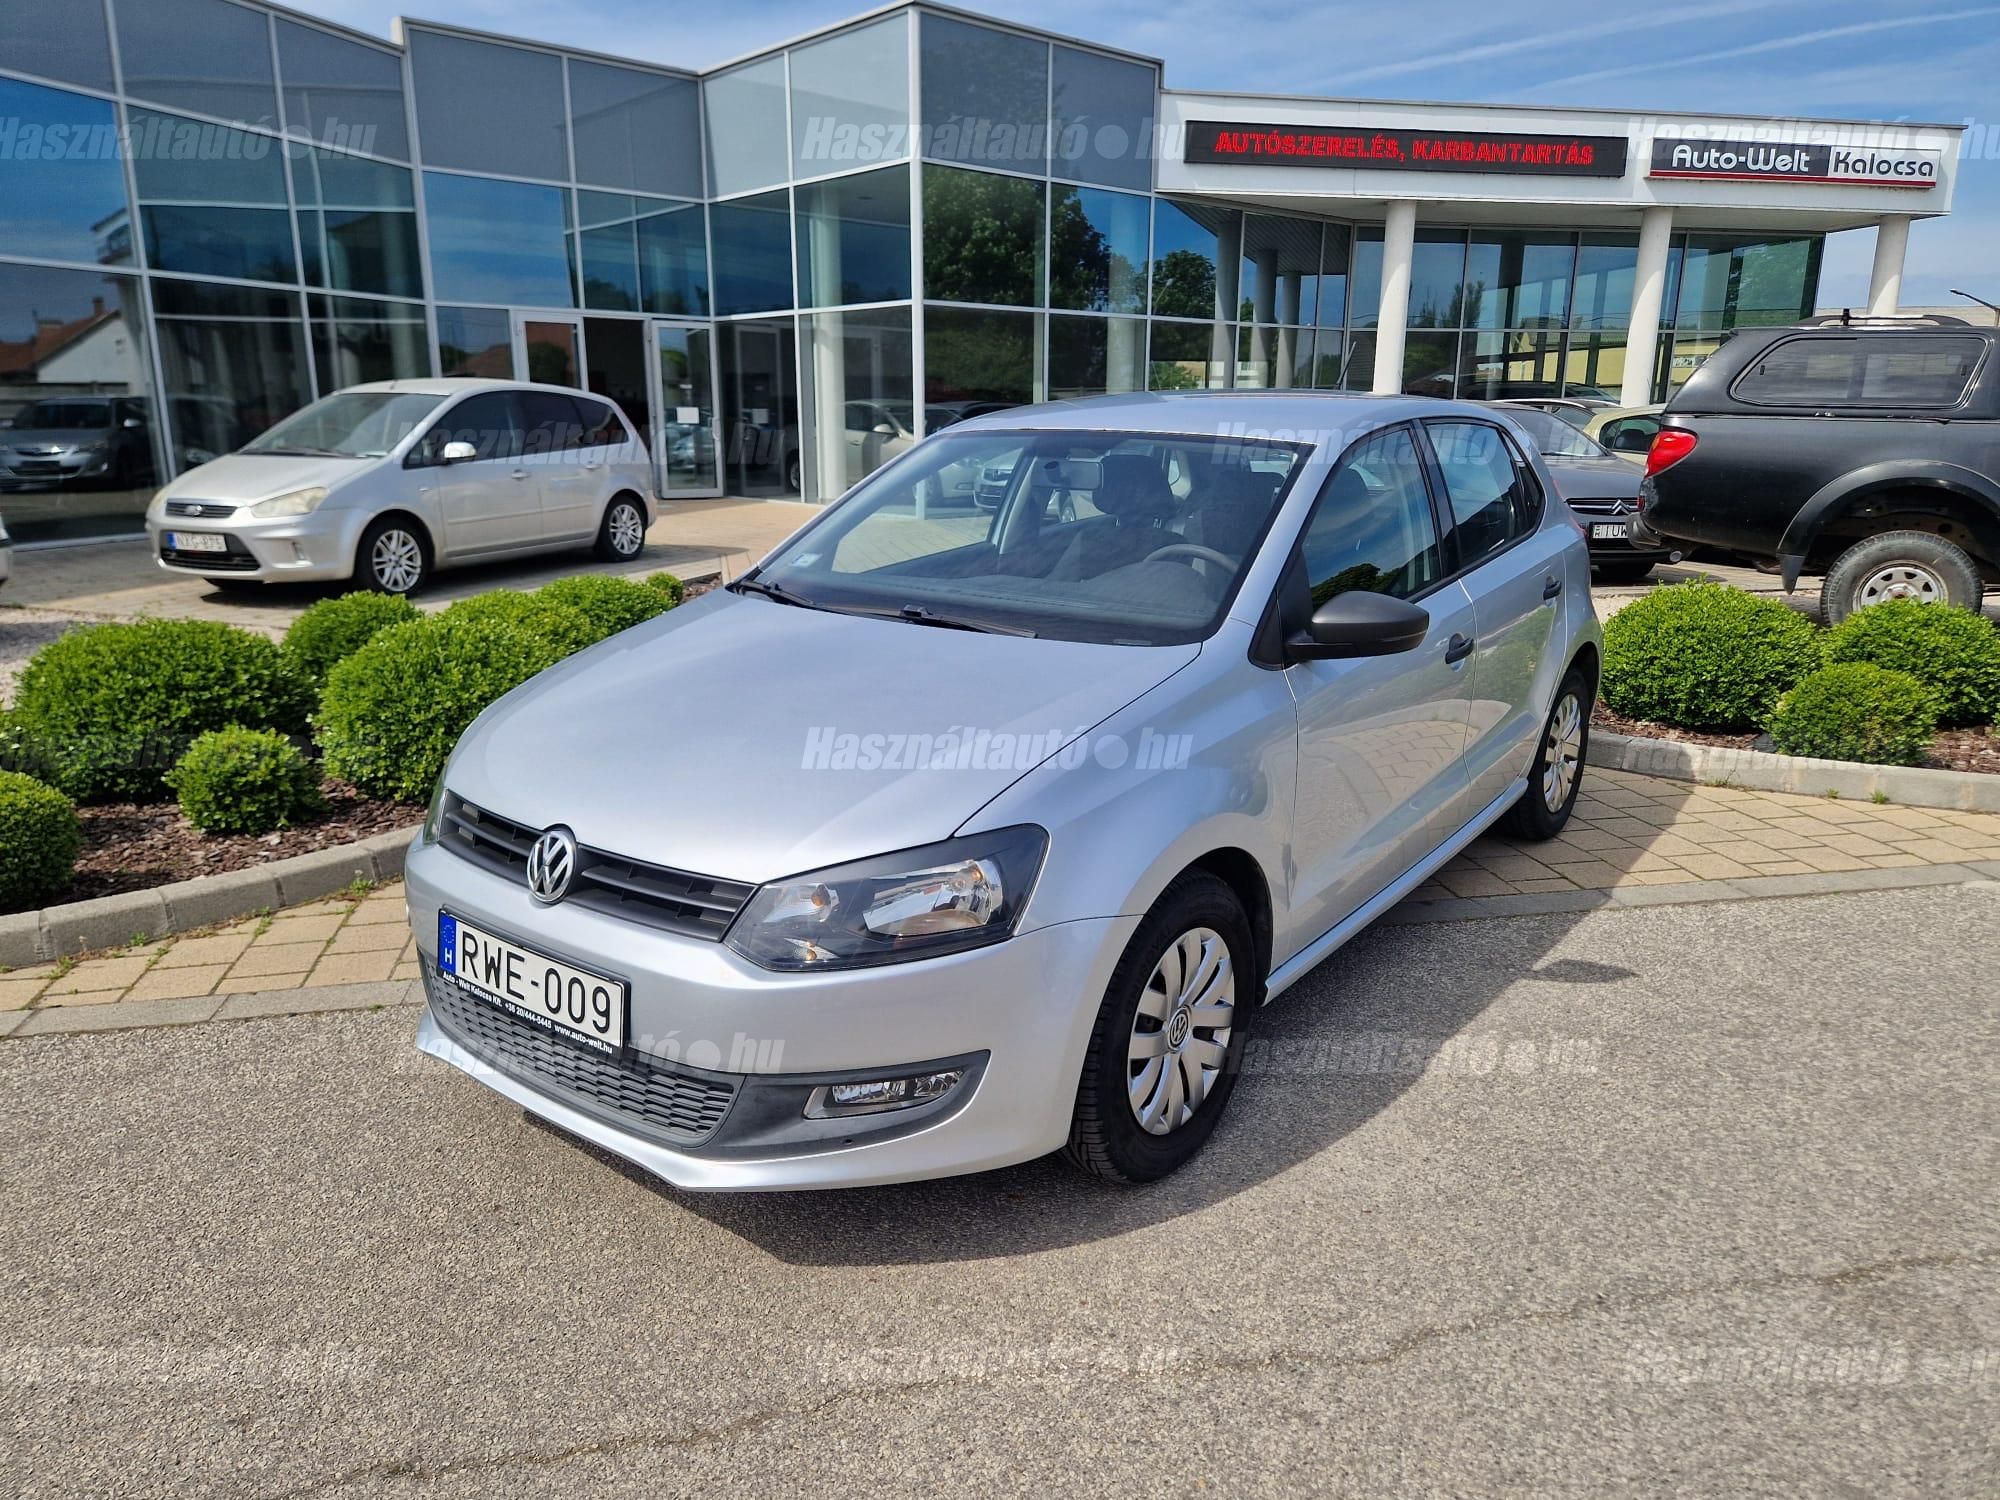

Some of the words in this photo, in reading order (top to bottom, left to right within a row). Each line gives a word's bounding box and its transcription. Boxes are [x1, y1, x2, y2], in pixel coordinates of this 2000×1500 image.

[1215, 130, 1406, 162] AUTÓSZERELÉS,
[1412, 138, 1595, 165] KARBANTARTÁS
[1672, 144, 1810, 173] Auto-Welt
[1833, 151, 1934, 177] Kalocsa
[444, 948, 453, 965] H
[462, 930, 611, 1034] RWE-009
[554, 1024, 613, 1055] www.auto-welt.hu
